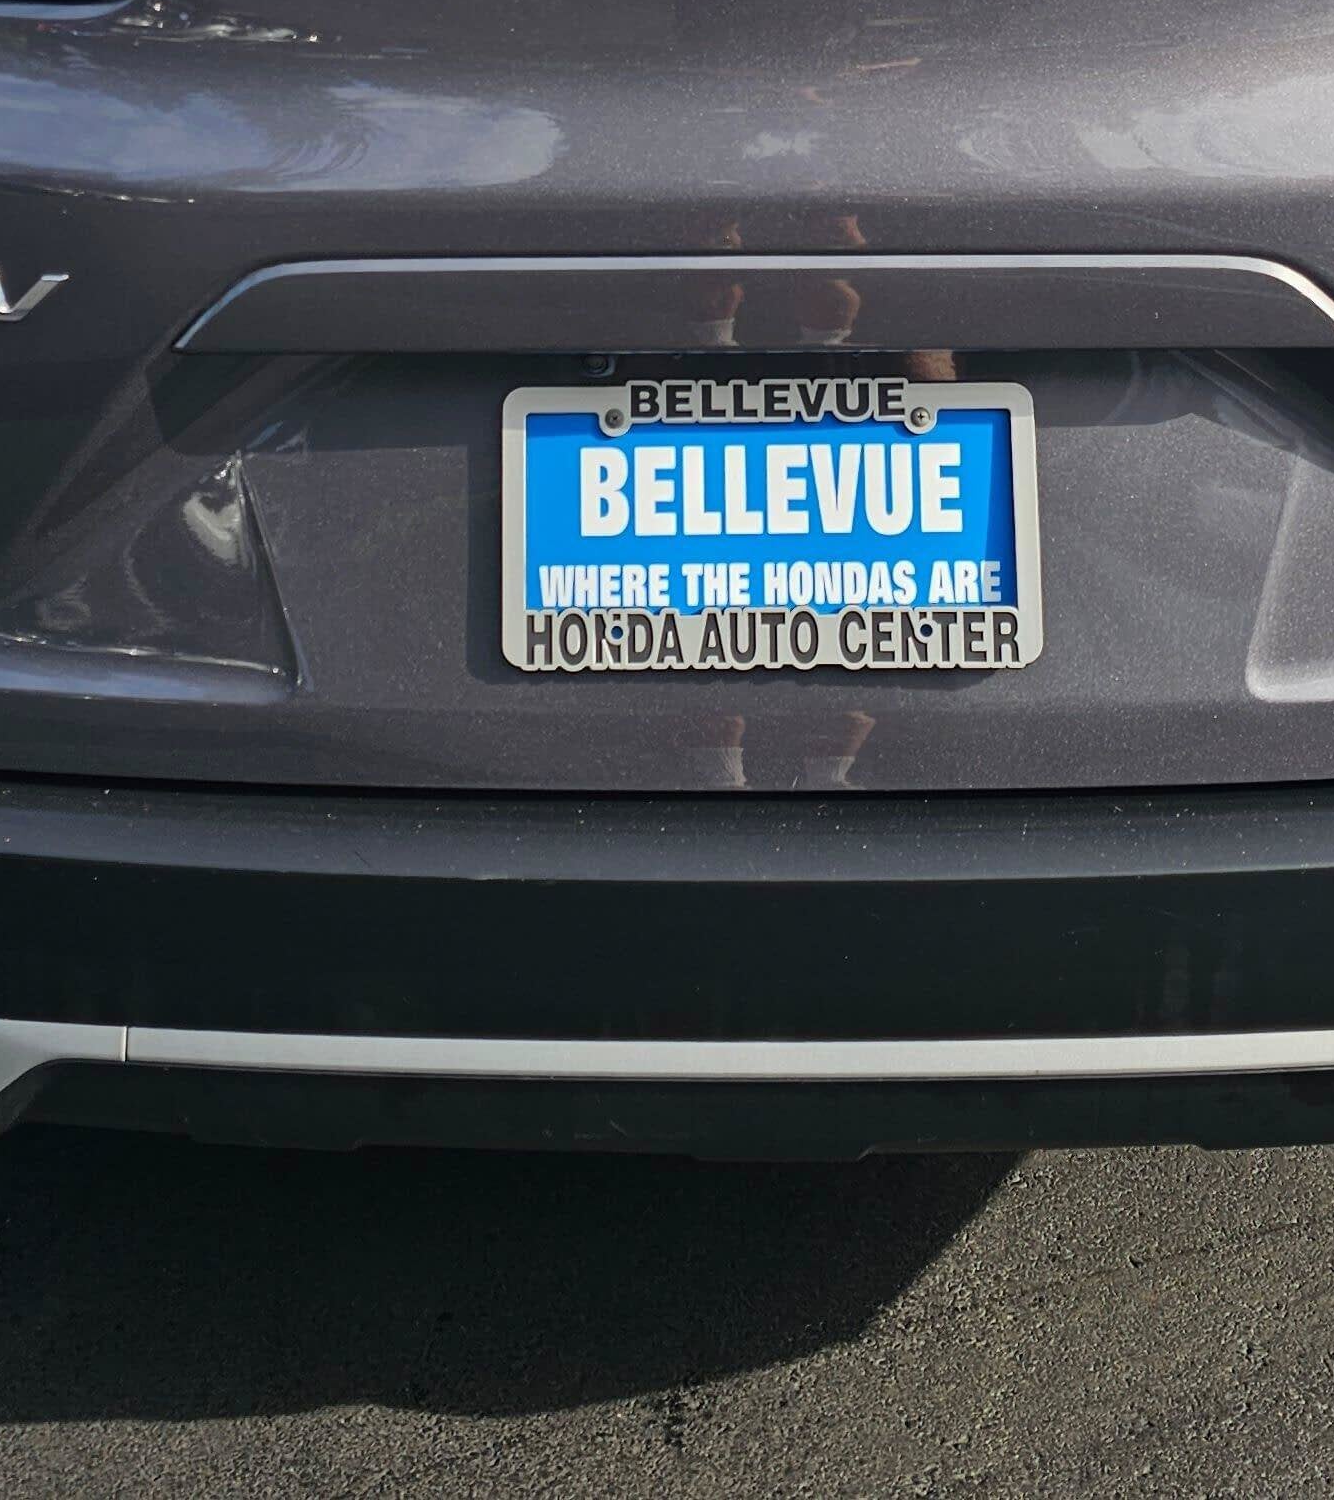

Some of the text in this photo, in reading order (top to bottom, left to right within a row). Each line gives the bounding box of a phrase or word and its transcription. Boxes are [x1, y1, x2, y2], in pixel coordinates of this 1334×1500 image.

[627, 380, 907, 420] BELLEVUE
[579, 442, 964, 538] BELLEVUE
[538, 559, 1003, 608] WHERE THE HONDAS ARE
[525, 609, 1021, 667] HONDA AUTO CENTER
